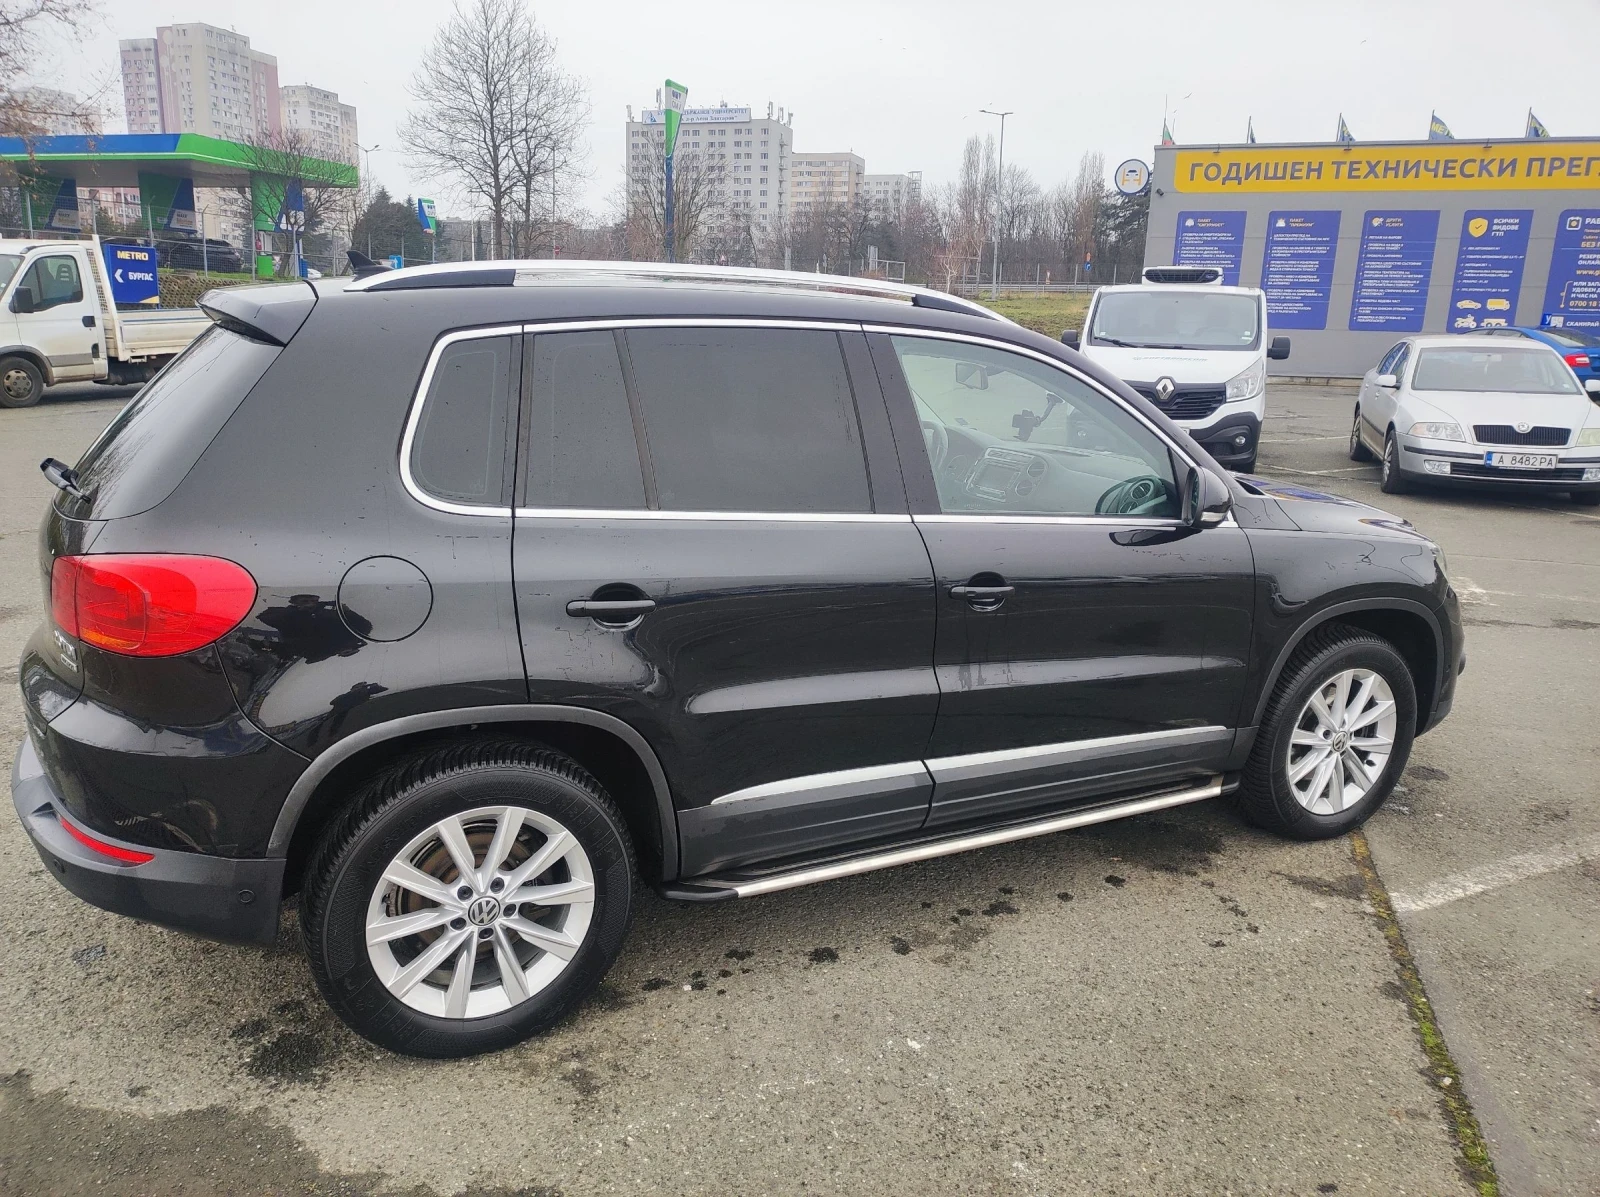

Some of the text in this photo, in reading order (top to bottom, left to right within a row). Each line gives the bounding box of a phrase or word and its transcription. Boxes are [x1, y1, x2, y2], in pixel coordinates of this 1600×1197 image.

[1189, 156, 1600, 186] ГОДИШЕН ТЕХНИЧЕСКИ ПРЕГ
[116, 250, 148, 261] METRO
[128, 271, 154, 282] БУРГАС
[1511, 456, 1538, 466] 8482
